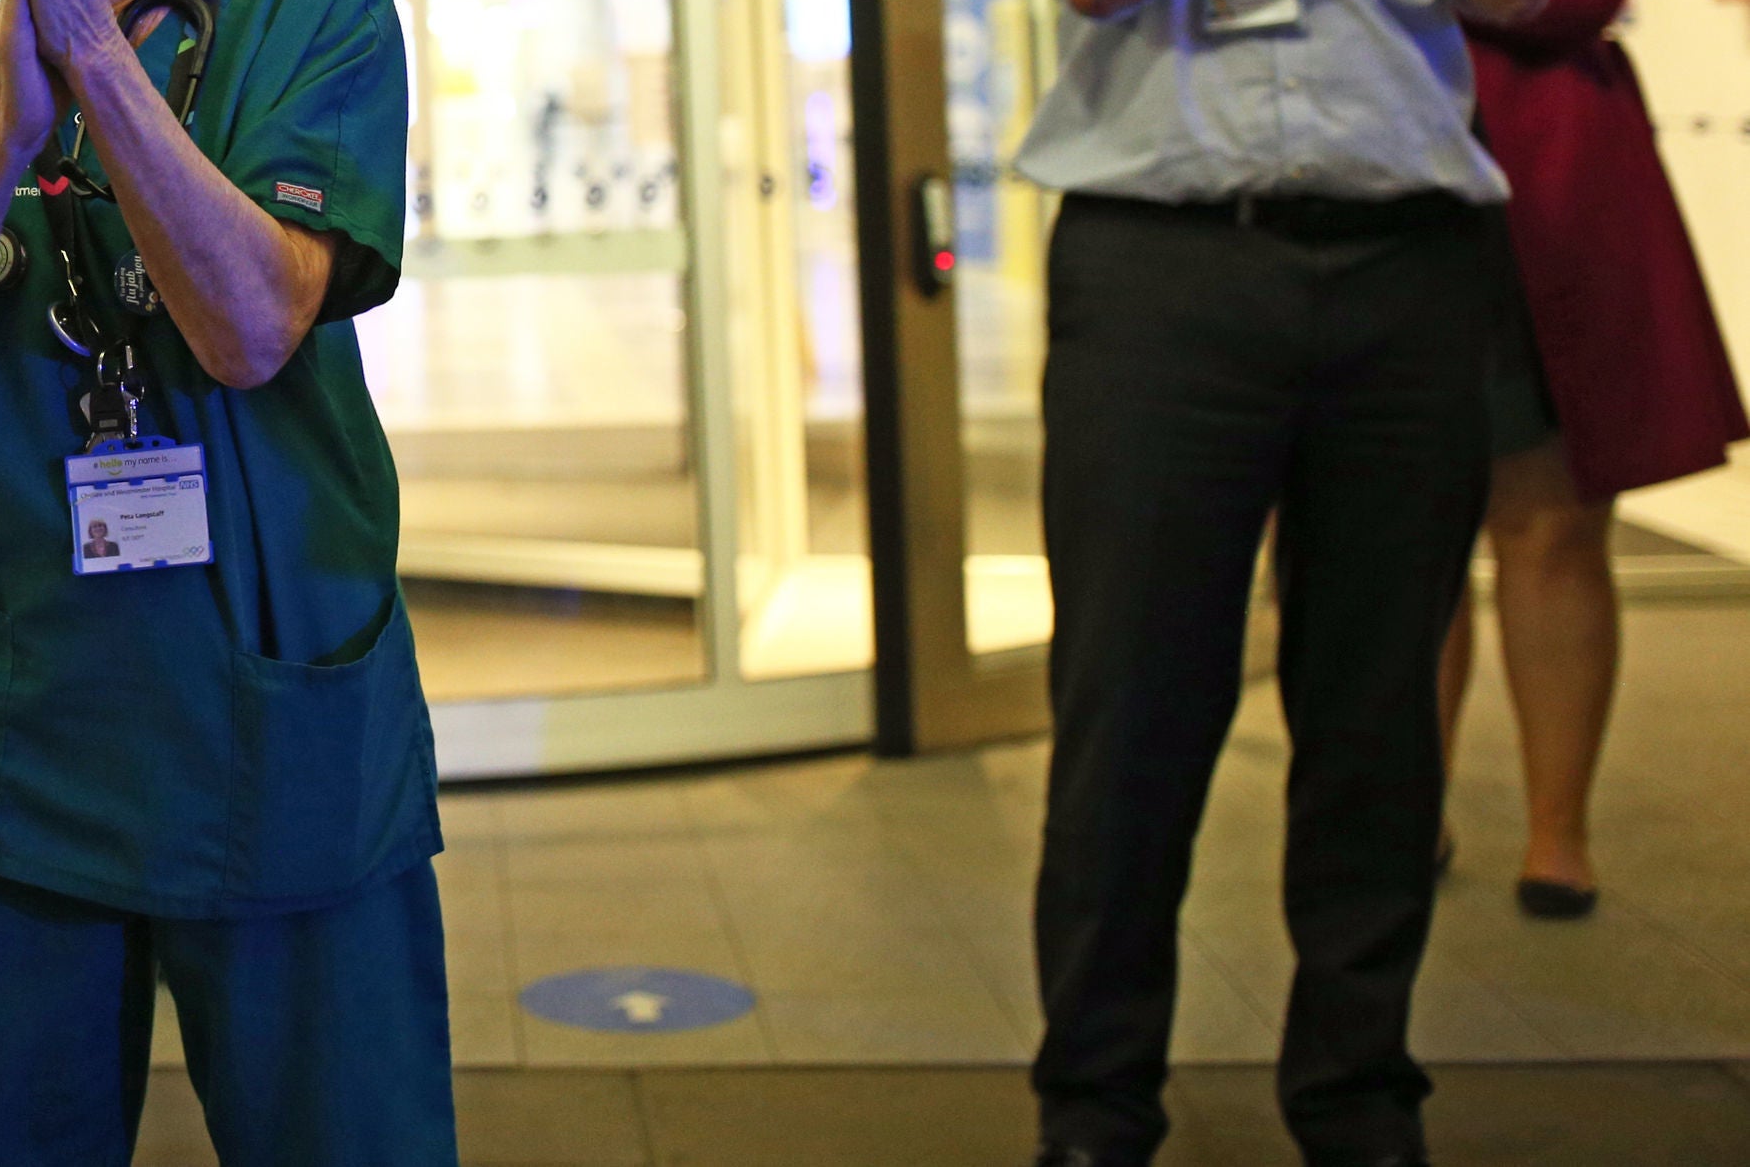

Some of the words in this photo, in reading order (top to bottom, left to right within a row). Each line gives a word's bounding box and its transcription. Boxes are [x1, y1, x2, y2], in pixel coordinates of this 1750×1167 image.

[126, 271, 138, 288] jab
[126, 289, 140, 304] flu
[124, 458, 138, 468] my
[138, 456, 160, 465] name
[180, 480, 198, 489] NHS
